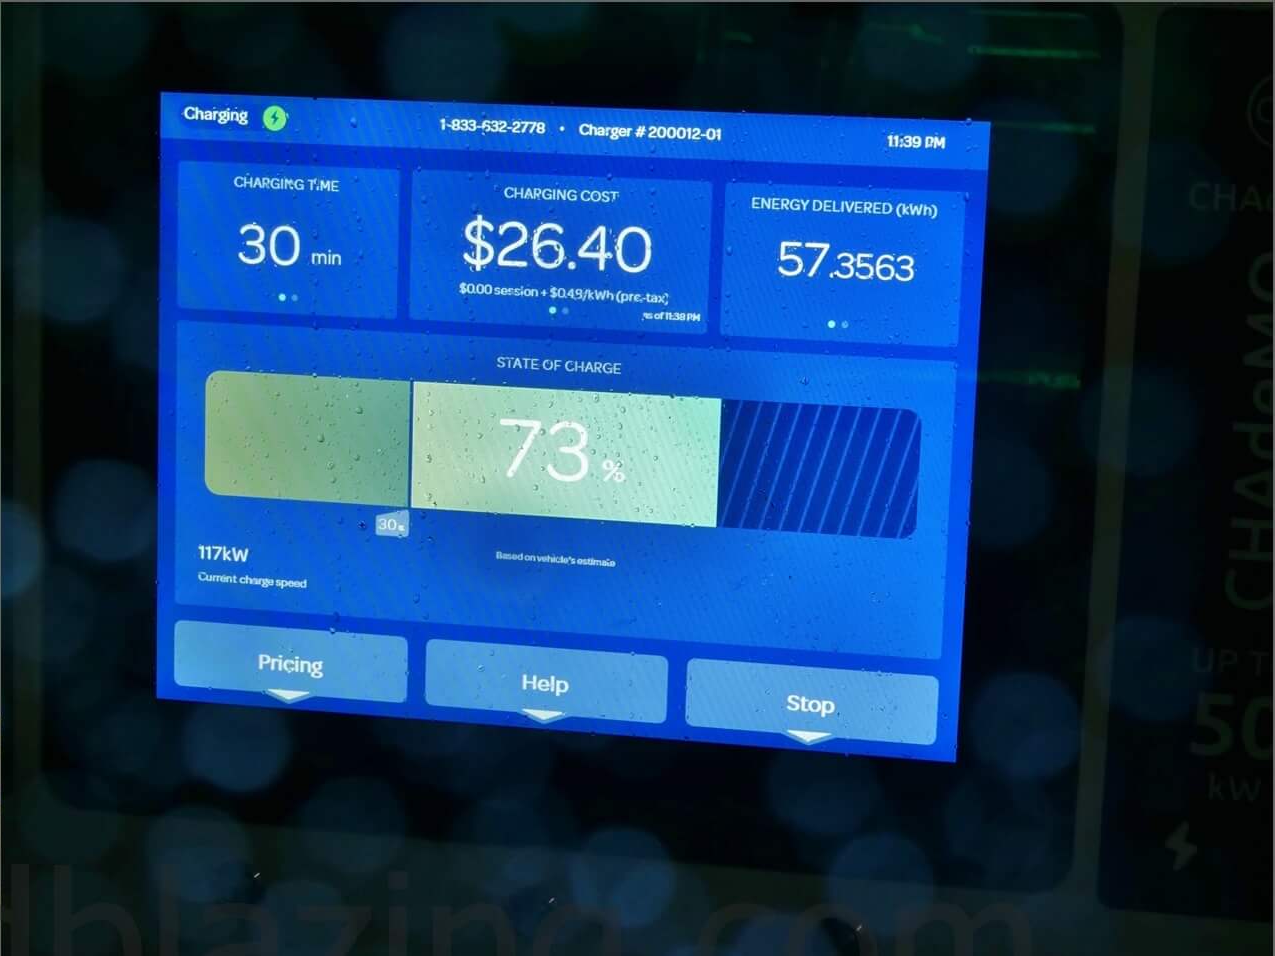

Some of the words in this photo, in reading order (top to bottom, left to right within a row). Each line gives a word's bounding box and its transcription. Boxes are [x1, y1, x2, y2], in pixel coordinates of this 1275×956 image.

[184, 106, 249, 125] Charging
[440, 117, 546, 136] 1-833-632-2778
[578, 123, 633, 139] Charger
[635, 125, 645, 138] #
[648, 126, 722, 142] 200012-01
[887, 134, 922, 149] 11:39
[925, 136, 945, 150] PM
[234, 175, 304, 191] CHARGING
[308, 178, 340, 193] TIME
[504, 187, 577, 201] CHARGING
[580, 190, 619, 204] COST
[751, 196, 810, 212] ENERGY
[812, 199, 892, 215] DELIVERED
[895, 203, 938, 219] (kWh)
[1189, 181, 1272, 213] CHA
[238, 223, 301, 267] 30
[312, 248, 342, 266] min
[463, 214, 652, 273] $26.40
[778, 241, 915, 282] 57.3563
[459, 282, 493, 295] $0.00
[494, 286, 538, 297] session
[550, 287, 615, 301] $0.49/kWh
[616, 290, 669, 305] (pre-tax)
[497, 357, 539, 370] STATE
[542, 359, 562, 372] OF
[565, 360, 622, 375] CHARGE
[500, 418, 589, 482] 73
[602, 460, 626, 482] %
[198, 545, 248, 562] 117kW
[496, 551, 523, 561] Based
[537, 554, 575, 565] vehicle's
[577, 557, 615, 567] estimate
[198, 572, 237, 584] Current
[239, 575, 274, 588] charge
[276, 576, 307, 589] speed
[258, 654, 323, 679] Pricing
[522, 674, 569, 697] Help
[787, 695, 835, 717] Stop
